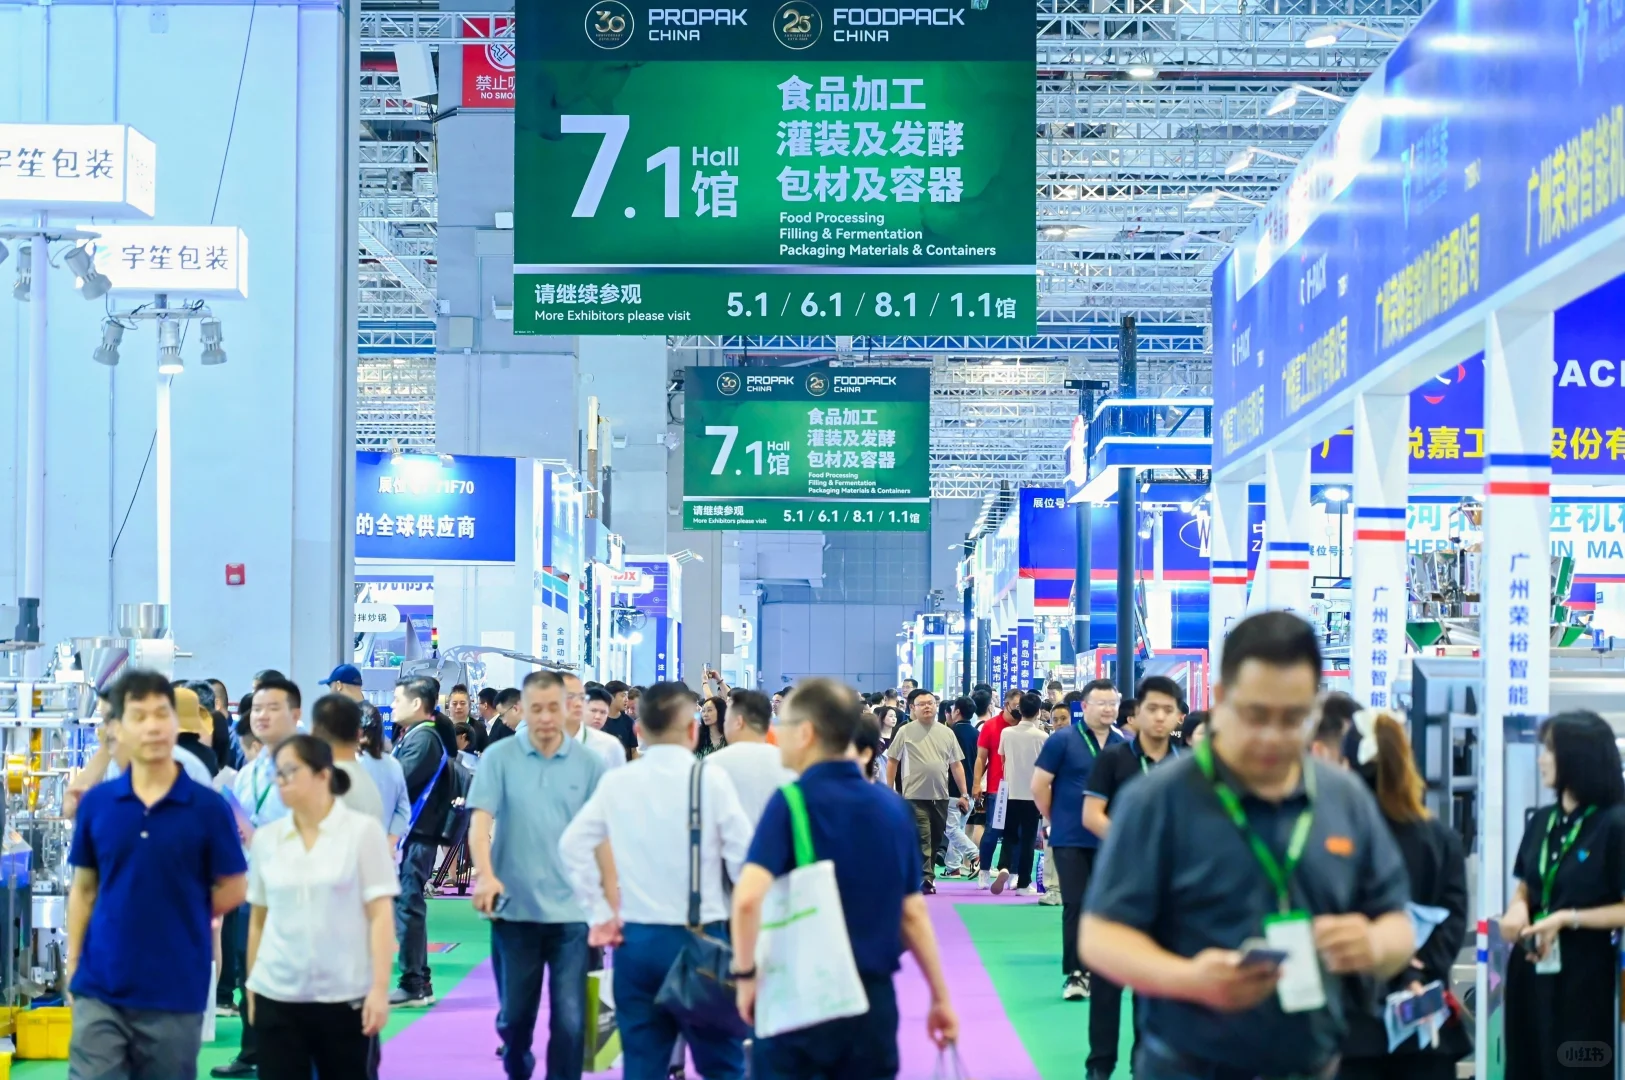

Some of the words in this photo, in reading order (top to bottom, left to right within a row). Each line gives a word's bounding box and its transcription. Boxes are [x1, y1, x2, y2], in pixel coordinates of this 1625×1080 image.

[648, 8, 748, 26] PROPAK
[833, 8, 965, 26] FOODPACK
[648, 29, 700, 41] CHINA
[833, 30, 889, 42] CHINA
[777, 74, 926, 112] 食品加工
[776, 120, 964, 157] 灌装及发酵
[692, 146, 739, 167] Hall
[560, 114, 680, 219] 7.1
[776, 165, 964, 203] 包材及容器
[691, 169, 739, 218] 馆
[779, 211, 812, 223] Food
[815, 211, 885, 227] Processing
[779, 227, 818, 243] Filling
[821, 227, 832, 240] &
[836, 228, 923, 240] Fermentation
[122, 244, 229, 271] 宇笙包装
[779, 243, 846, 259] Packaging
[849, 244, 909, 256] Materials
[912, 243, 923, 256] &
[926, 244, 997, 256] Containers
[534, 283, 642, 305] 请继续参观
[727, 292, 767, 317] 5.1
[800, 292, 842, 317] 6.1
[874, 292, 916, 317] 8.1
[950, 292, 1017, 319] 1.1馆
[535, 310, 564, 321] More
[567, 309, 625, 321] Exhibitors
[627, 310, 665, 323] please
[667, 310, 691, 321] visit
[746, 375, 794, 385] PROPAK
[833, 376, 897, 386] FOODPACK
[807, 407, 878, 426] 食品加工
[767, 440, 790, 451] Hall
[806, 428, 896, 448] 灌装及发酵
[705, 425, 763, 476] 7.1
[806, 449, 896, 469] 包材及容器
[767, 452, 790, 476] 馆
[808, 479, 828, 488] Filling
[825, 471, 859, 480] Processing
[808, 487, 838, 495] Packaging
[692, 505, 744, 516] 请继续参观
[783, 509, 803, 522] 5.1
[817, 510, 838, 523] 6.1
[852, 509, 873, 523] 8.1
[888, 510, 920, 524] 1.1馆
[356, 512, 476, 540] 的全球供应商
[355, 613, 387, 622] 拌炒锅
[1507, 552, 1531, 716] 广州荣裕智能
[1371, 586, 1389, 707] 广州荣裕智能
